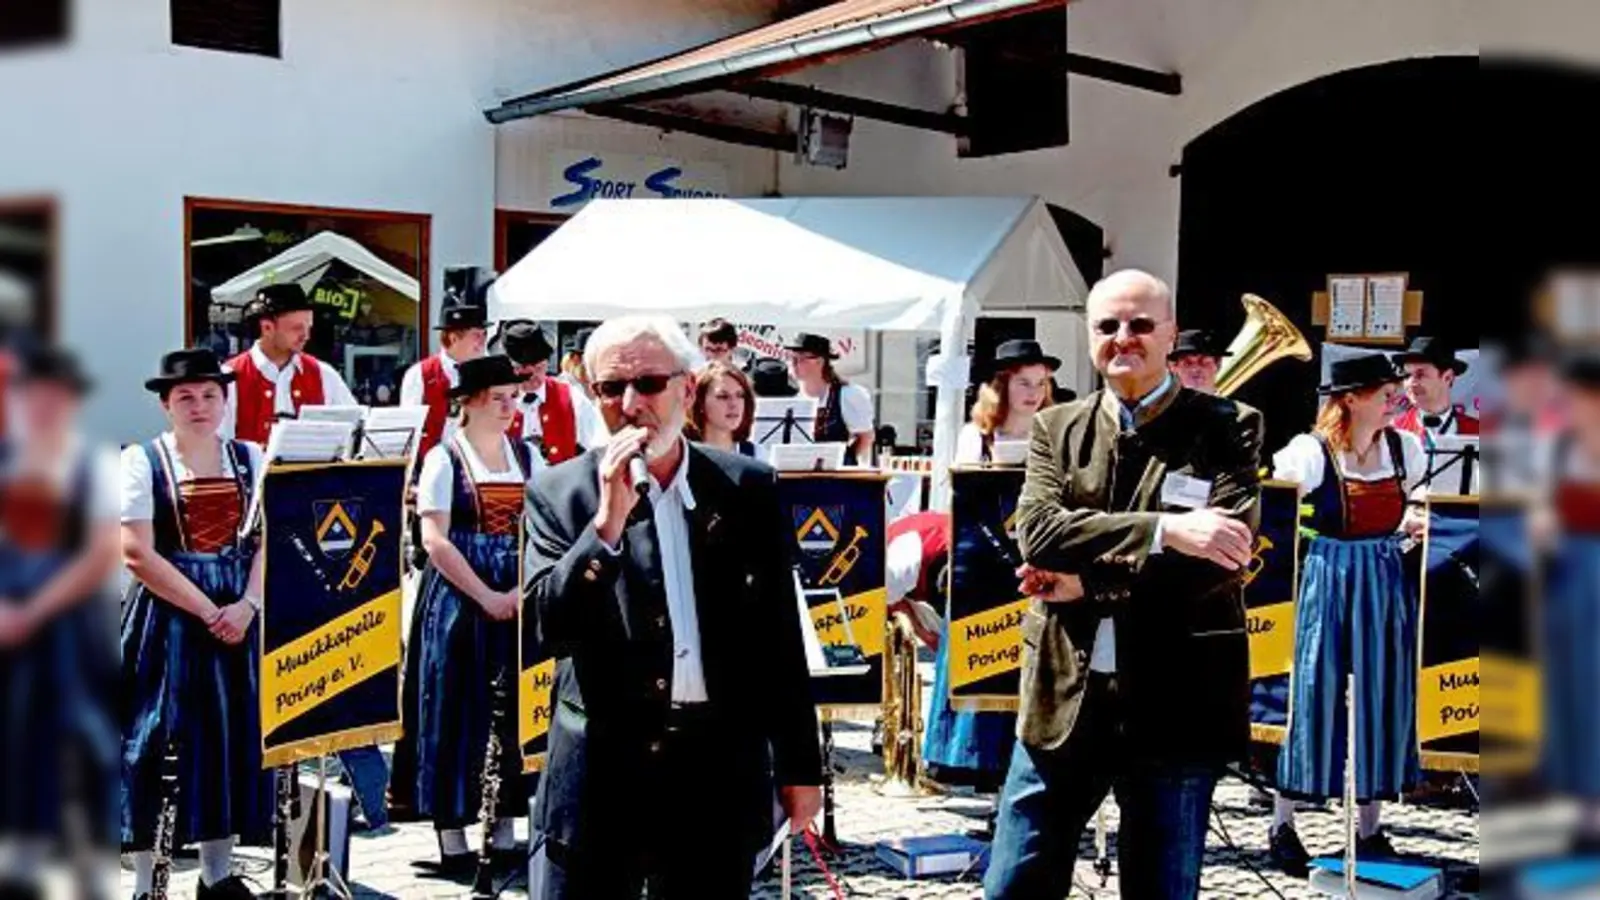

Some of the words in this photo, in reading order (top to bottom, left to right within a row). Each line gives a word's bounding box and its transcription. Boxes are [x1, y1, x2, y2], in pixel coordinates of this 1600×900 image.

[275, 610, 386, 677] Musikkapelle
[968, 644, 1020, 671] Poing
[275, 676, 326, 714] Poing
[348, 653, 365, 671] V.
